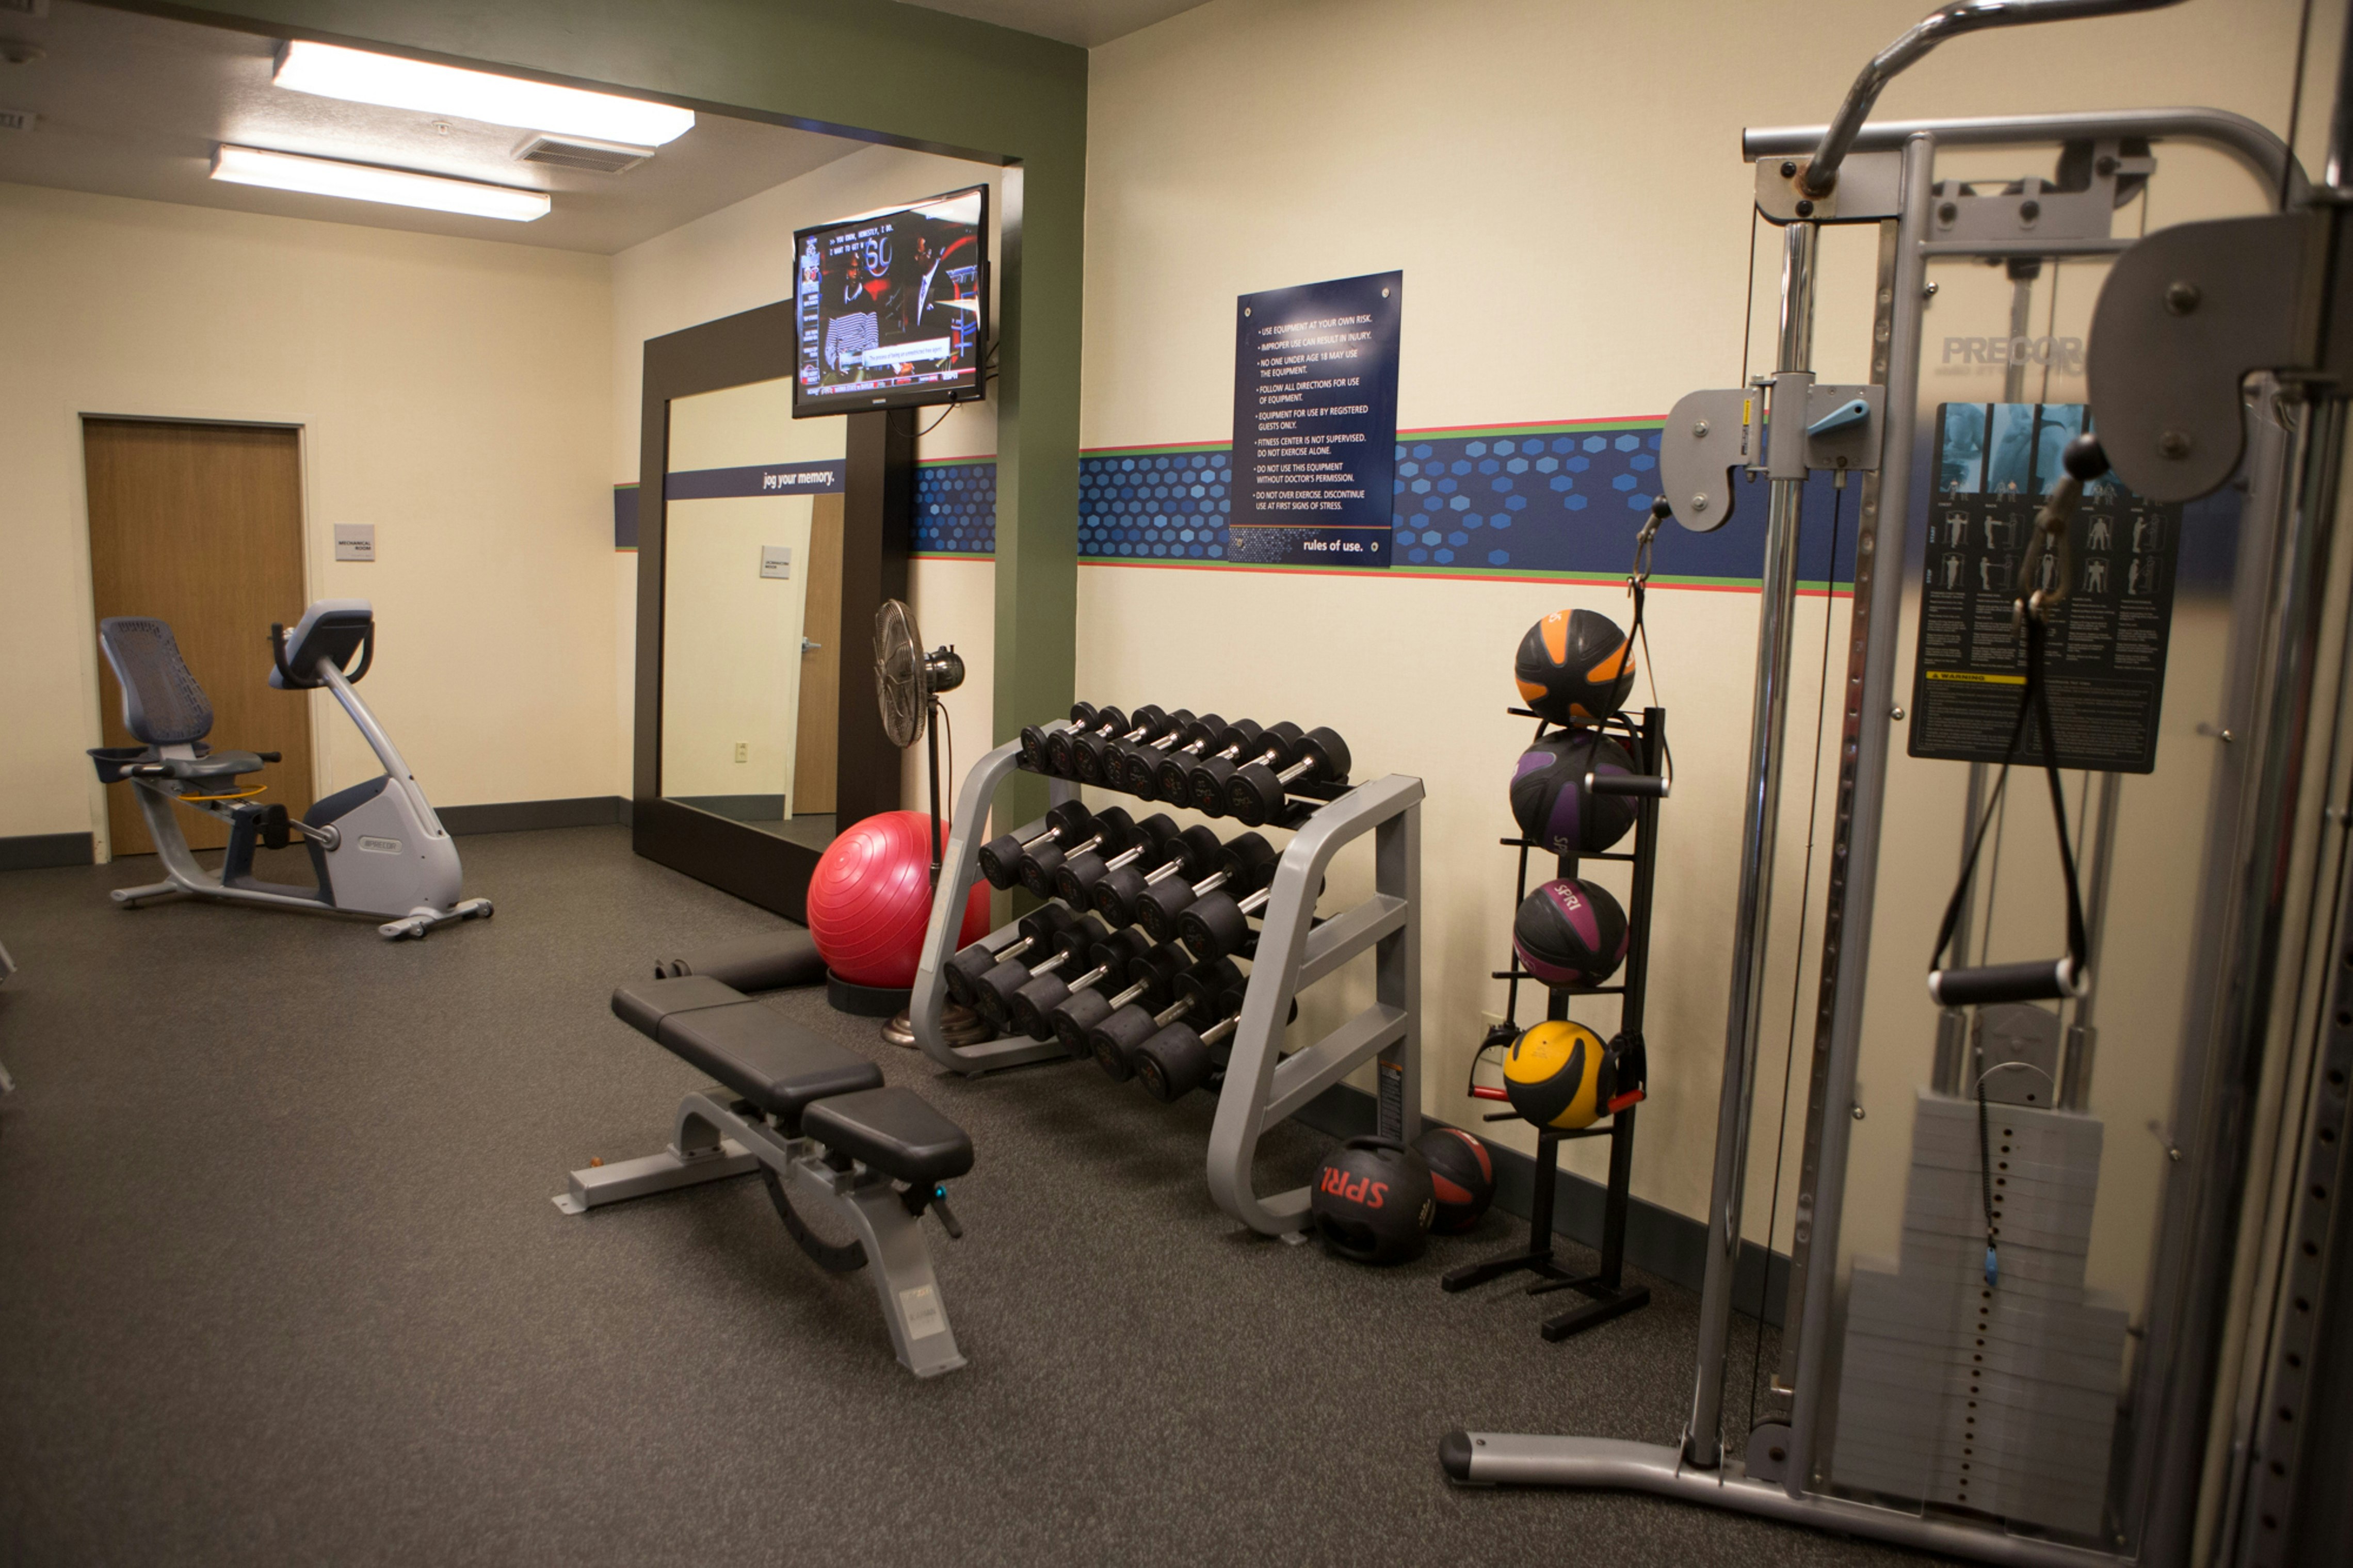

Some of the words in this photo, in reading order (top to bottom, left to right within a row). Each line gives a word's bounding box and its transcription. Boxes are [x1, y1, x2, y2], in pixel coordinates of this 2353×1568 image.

[1262, 327, 1272, 335] USE
[1273, 322, 1308, 333] EQUIPMENT
[1309, 321, 1317, 329] AT
[1318, 319, 1336, 328] YOUR
[1337, 317, 1355, 326] OWN
[1356, 314, 1372, 324] RISK.
[1261, 341, 1289, 351] IMPROPER
[1290, 340, 1301, 348] USE
[1302, 337, 1315, 346] CAN
[1317, 335, 1339, 345] RESULT
[1340, 334, 1347, 342] IN
[1347, 331, 1372, 342] INJURY.
[1942, 335, 2083, 366] PRECOR
[1260, 359, 1270, 367] NO
[1269, 357, 1283, 366] ONE
[1283, 355, 1304, 364] UNDER
[1305, 353, 1318, 362] AGE
[1320, 352, 1328, 361] 18
[1329, 351, 1344, 360] MAY
[1345, 349, 1358, 359] USE
[1272, 366, 1307, 377] EQUIPMENT.
[1259, 384, 1284, 393] FOLLOW
[1283, 383, 1295, 392] ALL
[1296, 380, 1332, 391] DIRECTIONS
[1332, 379, 1346, 387] FOR
[1347, 377, 1360, 386] USE
[1268, 394, 1303, 404] EQUIPMENT.
[1259, 410, 1293, 420] EQUIPMENT
[1293, 409, 1306, 418] FOR
[1306, 409, 1318, 417] USE
[1319, 408, 1329, 416] BY
[1329, 405, 1368, 415] REGISTERED
[1258, 422, 1279, 430] GUESTS
[1279, 421, 1297, 429] ONLY.
[1281, 436, 1303, 445] CENTER
[1304, 435, 1310, 444] IS
[1311, 435, 1325, 443] NOT
[1326, 434, 1366, 443] SUPERVISED.
[1280, 448, 1308, 456] EXERCISE
[1308, 447, 1331, 455] ALONE.
[1306, 462, 1343, 471] EQUIPMENT
[763, 472, 777, 489] jog
[778, 474, 797, 488] your
[798, 471, 835, 486] memory.
[1315, 474, 1354, 482] PERMISSION.
[1323, 490, 1365, 498] DISCONTINUE
[1303, 540, 1327, 551] rules
[1329, 540, 1341, 551] of
[1343, 541, 1363, 551] use.
[1554, 884, 1582, 911] SPRI
[1320, 1167, 1389, 1209] SPRI
